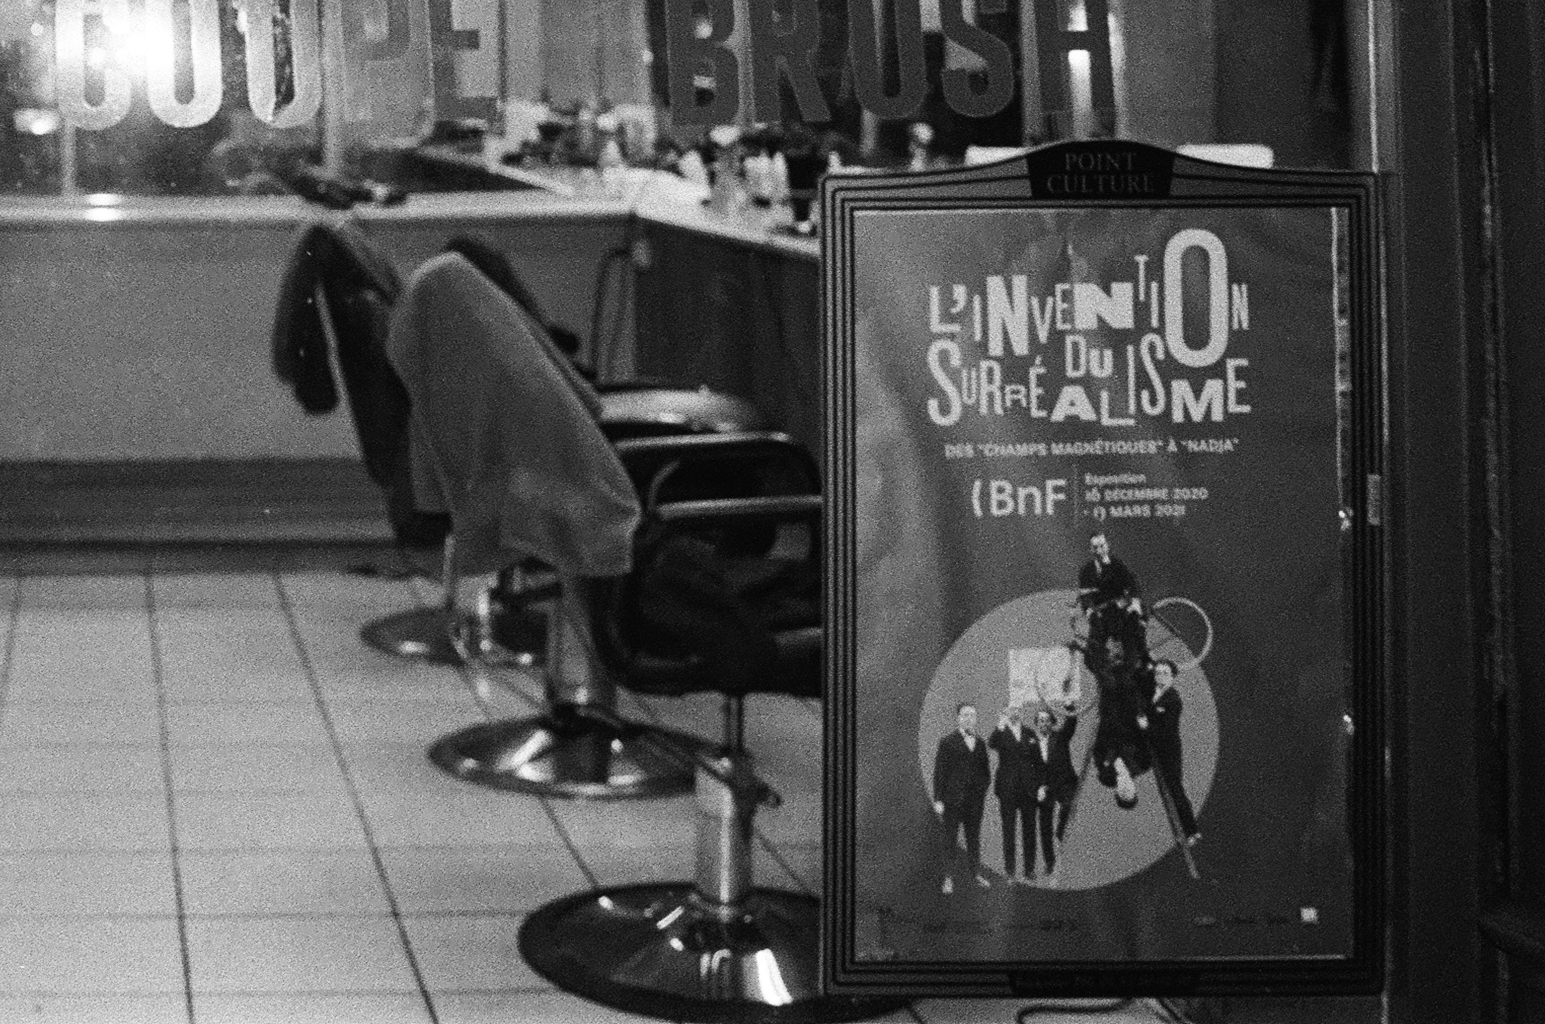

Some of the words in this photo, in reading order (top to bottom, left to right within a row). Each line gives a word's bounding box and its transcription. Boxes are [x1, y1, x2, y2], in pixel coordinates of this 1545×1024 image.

[1065, 151, 1137, 172] POINT
[1047, 174, 1154, 194] CULTURE
[944, 443, 974, 459] DES
[1173, 487, 1209, 501] 2020
[1109, 505, 1152, 519] MARS
